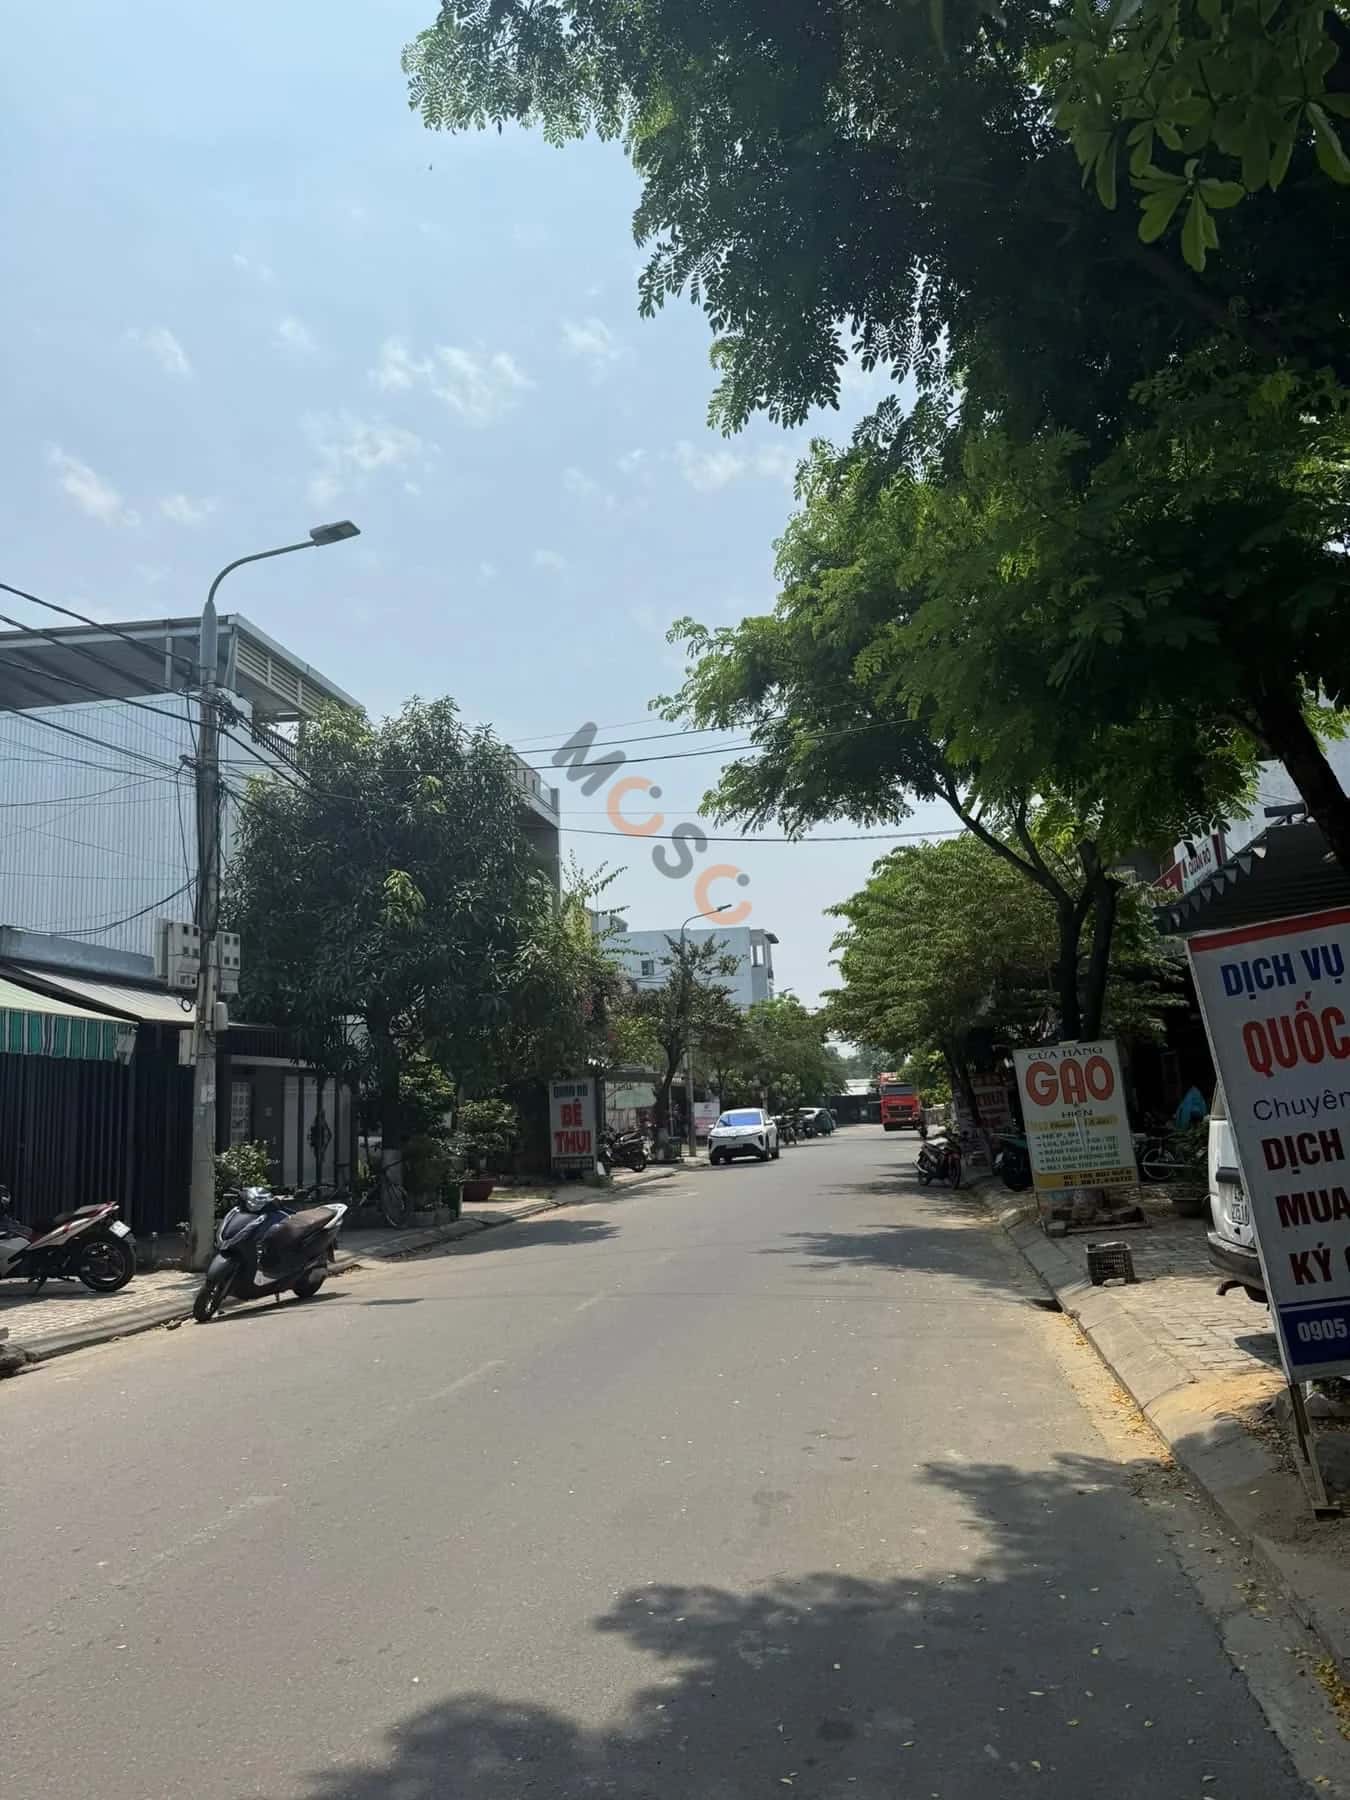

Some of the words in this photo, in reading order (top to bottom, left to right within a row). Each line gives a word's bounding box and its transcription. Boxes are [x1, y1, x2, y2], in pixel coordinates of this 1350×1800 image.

[1220, 951, 1296, 1000] DỊCH
[1299, 943, 1345, 984] VỤ
[1242, 990, 1350, 1078] QUỐC
[1260, 1127, 1345, 1175] DỊCH
[1275, 1186, 1350, 1228] MUA
[1288, 1242, 1333, 1285] KÝ
[1296, 1317, 1347, 1342] 0905
